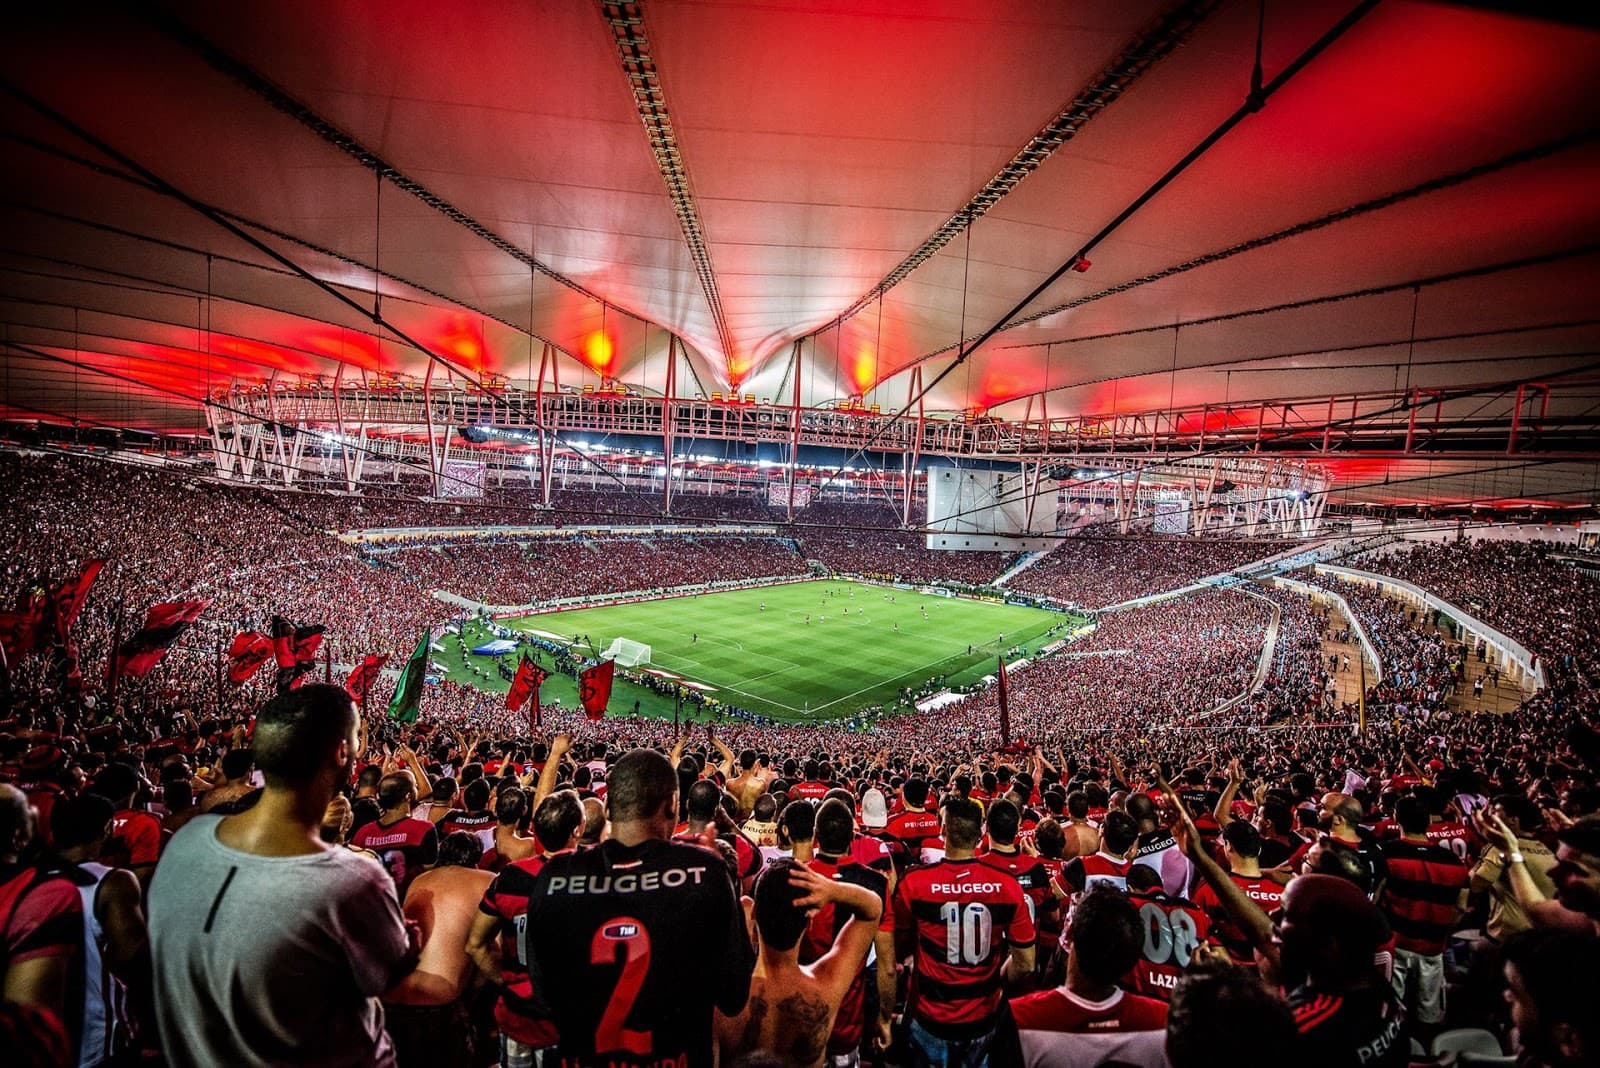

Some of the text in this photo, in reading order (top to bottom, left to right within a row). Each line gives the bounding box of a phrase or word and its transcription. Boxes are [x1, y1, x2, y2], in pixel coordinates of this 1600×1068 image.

[547, 867, 707, 895] PEUGEOT
[931, 883, 1002, 893] PEUGEOT
[940, 901, 992, 966] 10
[590, 916, 652, 1055] 2
